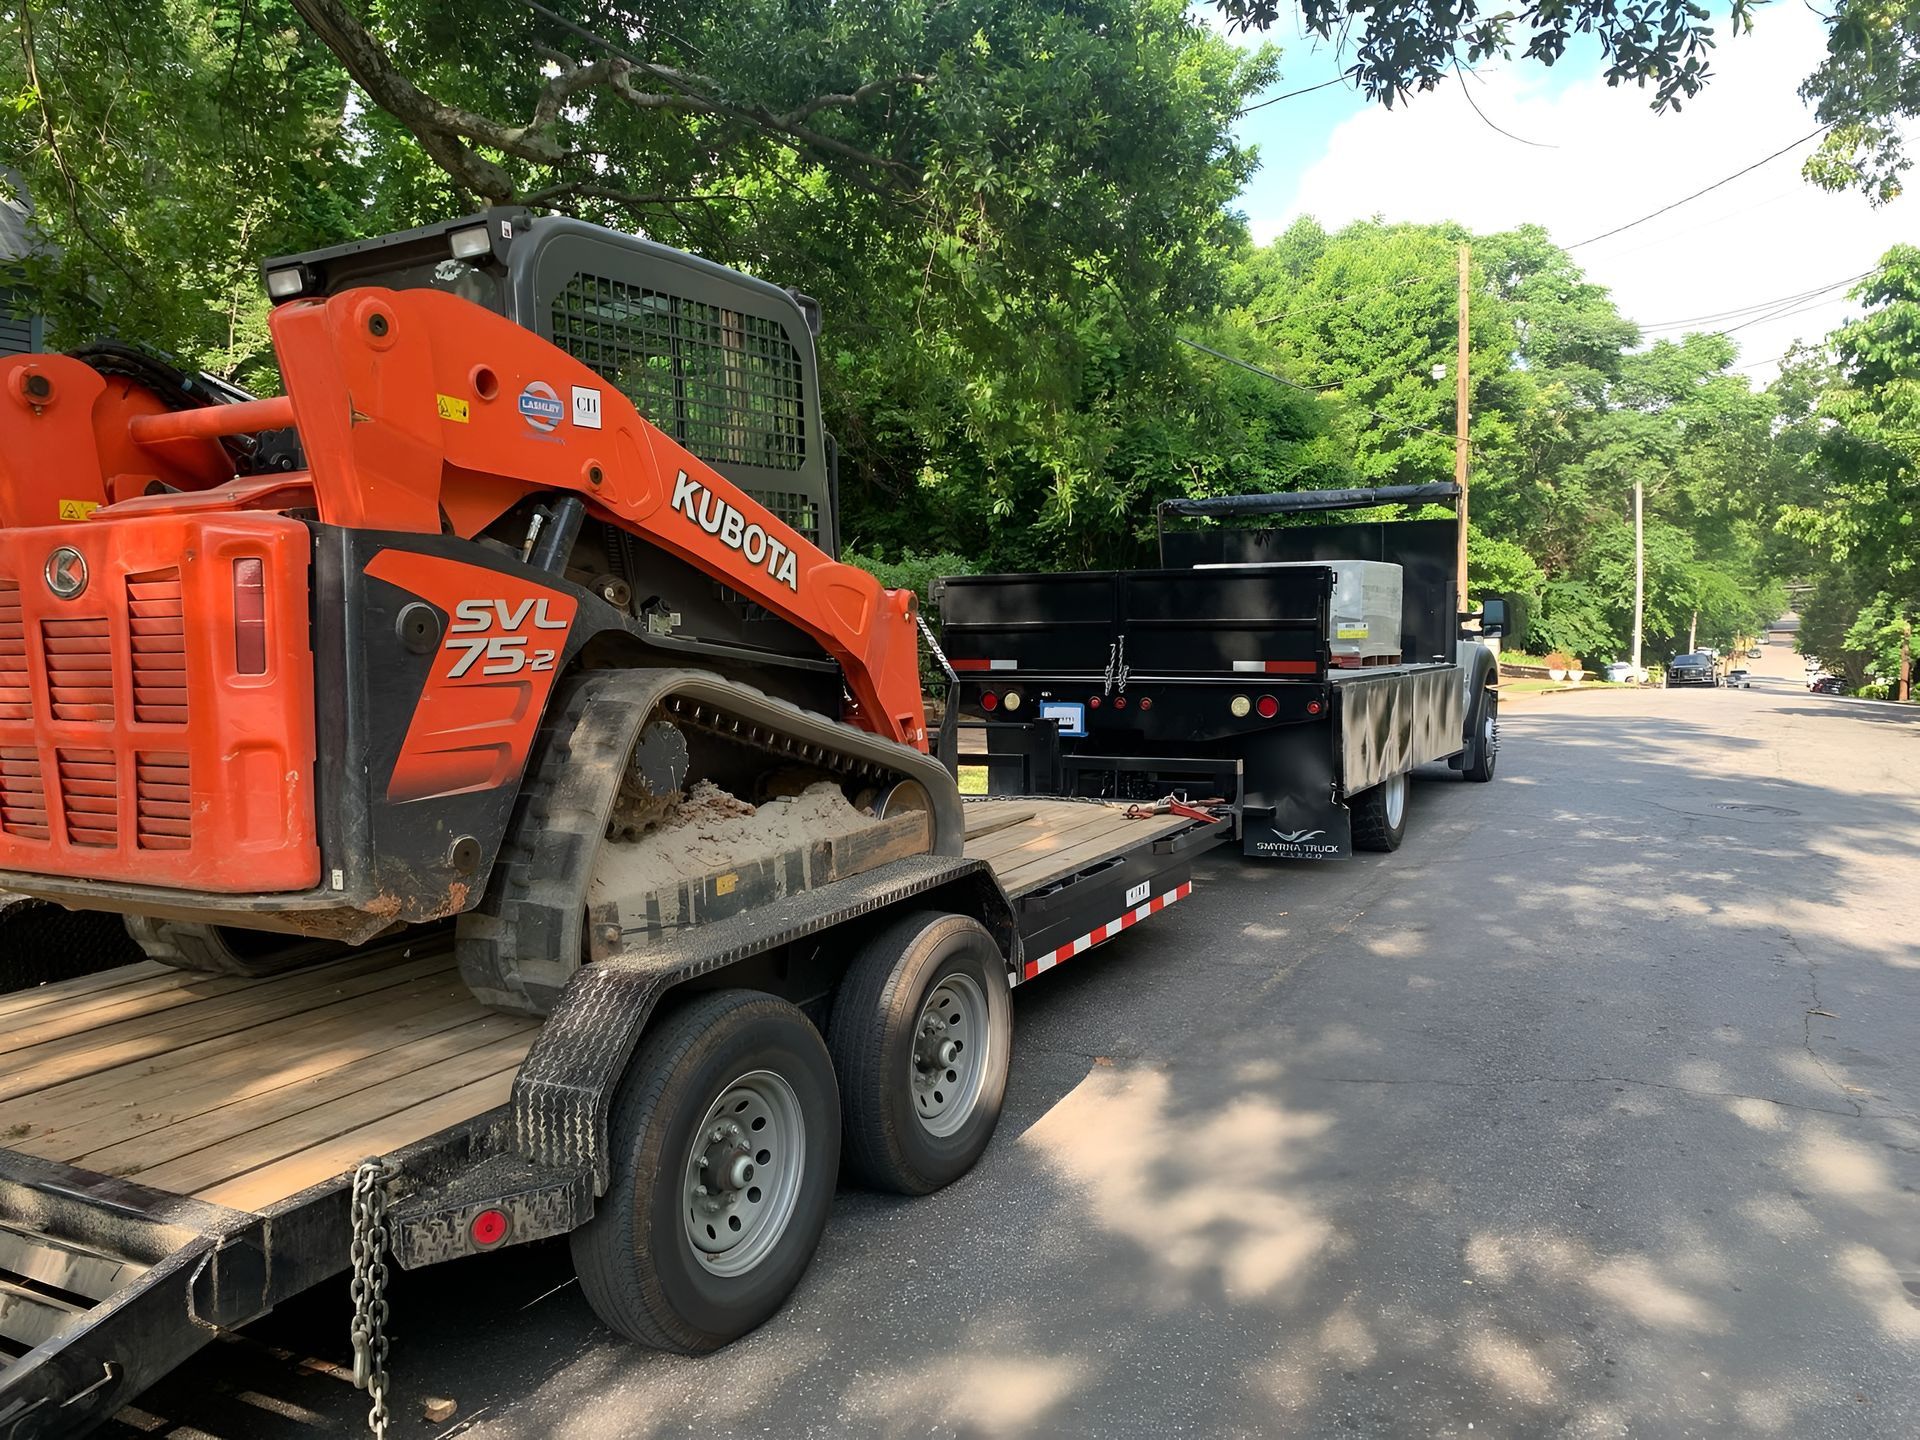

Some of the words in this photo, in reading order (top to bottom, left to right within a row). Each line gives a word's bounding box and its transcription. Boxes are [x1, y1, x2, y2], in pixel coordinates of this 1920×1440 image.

[671, 469, 798, 592] KUBOTA
[451, 598, 568, 633] SVL
[444, 636, 556, 678] 75-2
[1304, 844, 1339, 853] TRUCK
